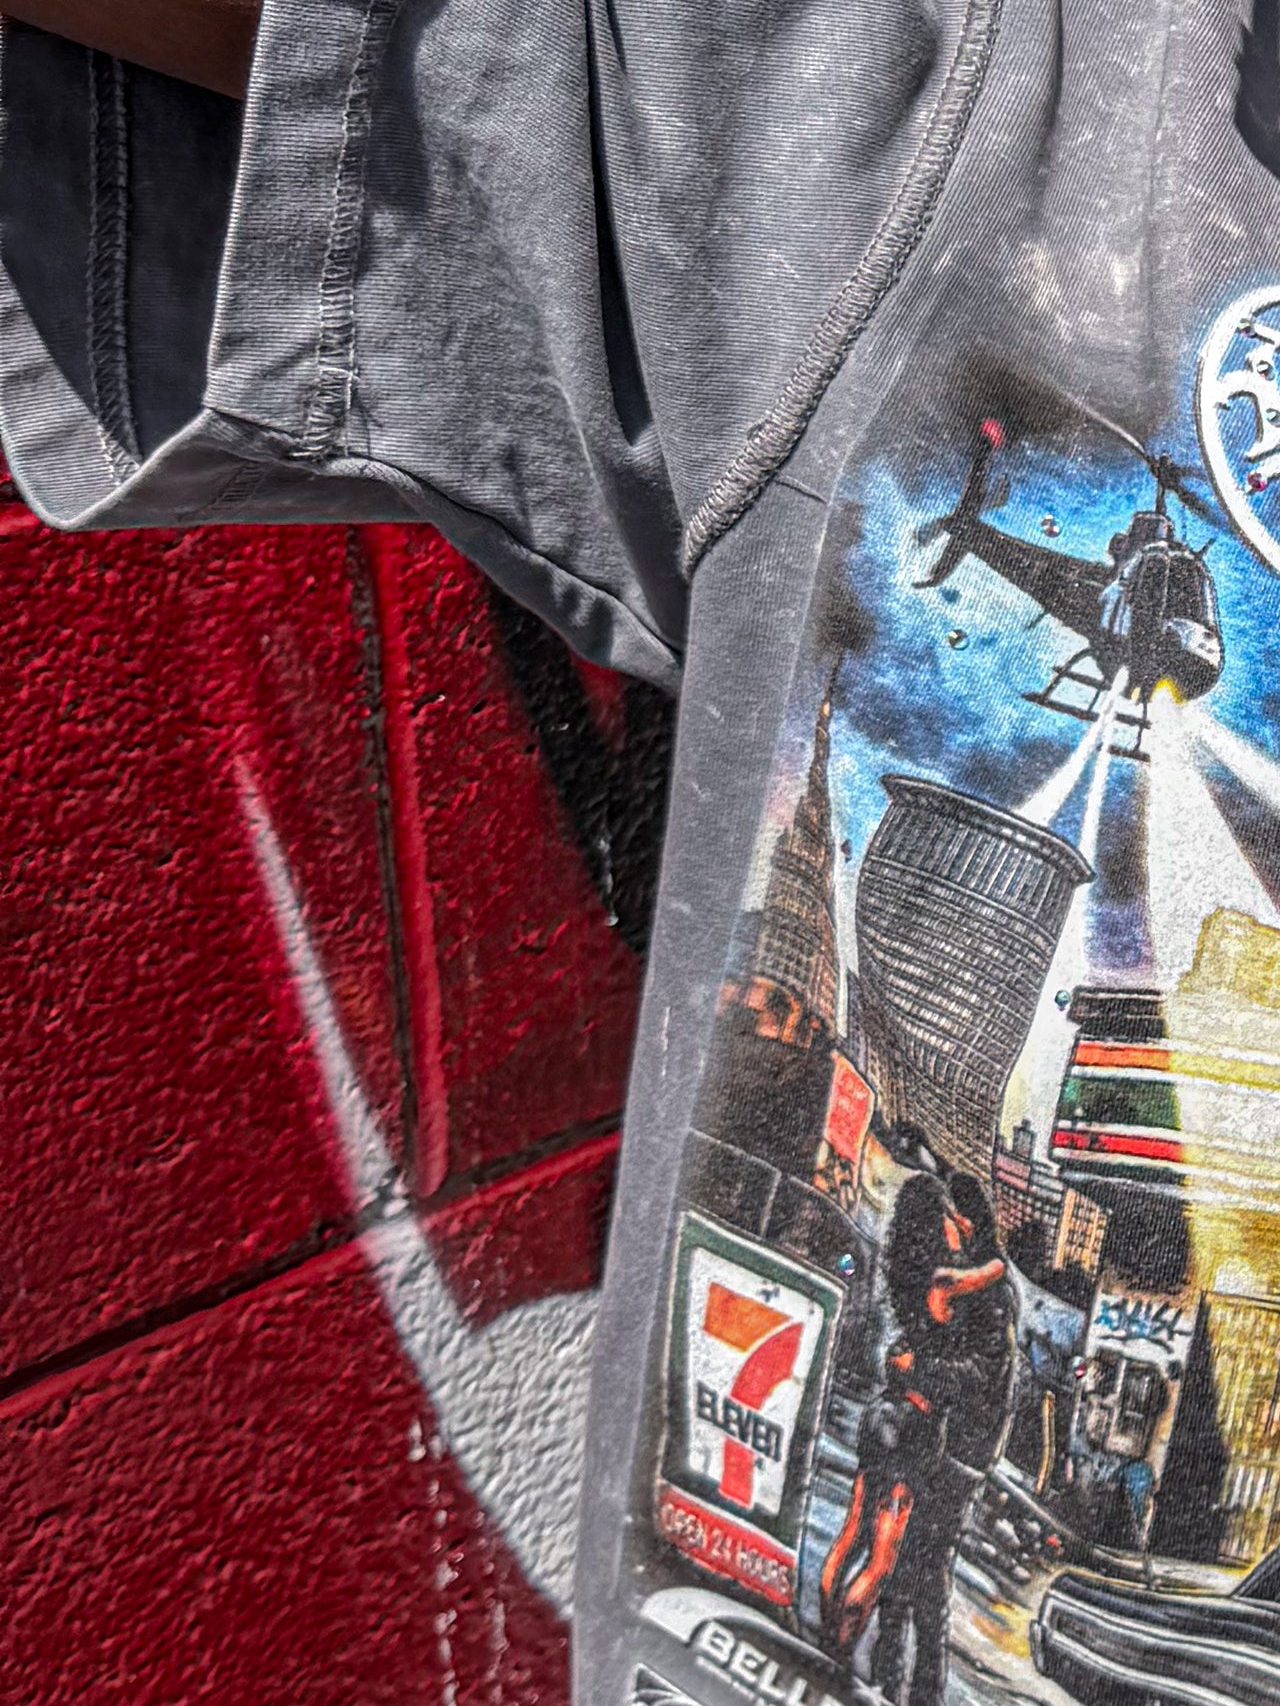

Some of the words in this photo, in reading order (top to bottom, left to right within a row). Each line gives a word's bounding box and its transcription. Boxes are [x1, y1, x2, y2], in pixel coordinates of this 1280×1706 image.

[661, 1500, 708, 1548] OPEN
[709, 1524, 734, 1561] 24
[735, 1540, 792, 1595] HOURS
